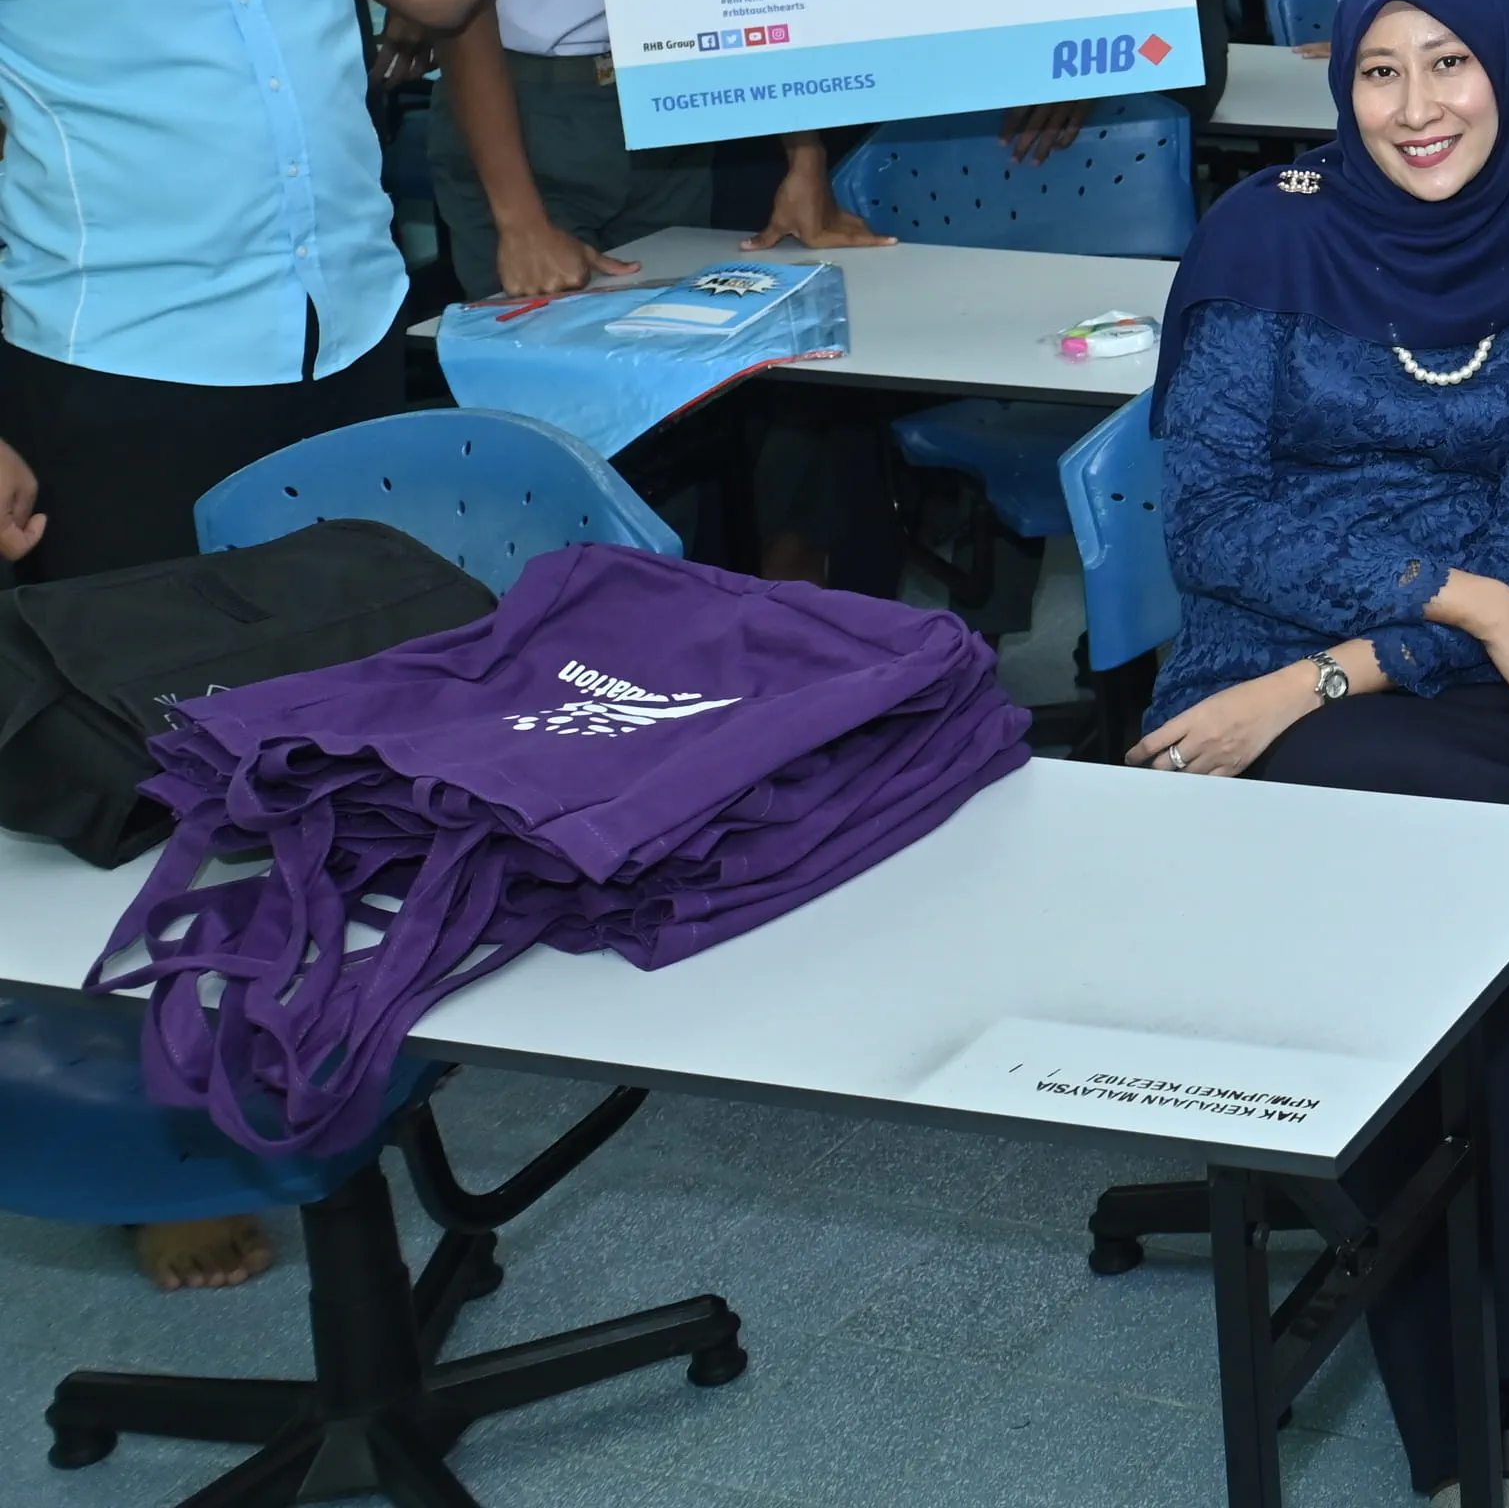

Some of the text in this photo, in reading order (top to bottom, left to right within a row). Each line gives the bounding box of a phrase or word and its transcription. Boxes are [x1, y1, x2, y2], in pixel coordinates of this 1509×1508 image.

[722, 2, 805, 18] #rhbtouchhearts
[643, 38, 696, 52] RHB Group
[1052, 34, 1136, 80] RHB
[651, 73, 876, 112] TOGETHER WE PROGRESS
[1036, 1080, 1308, 1123] HAK KERAJAAN MALAYSIA
